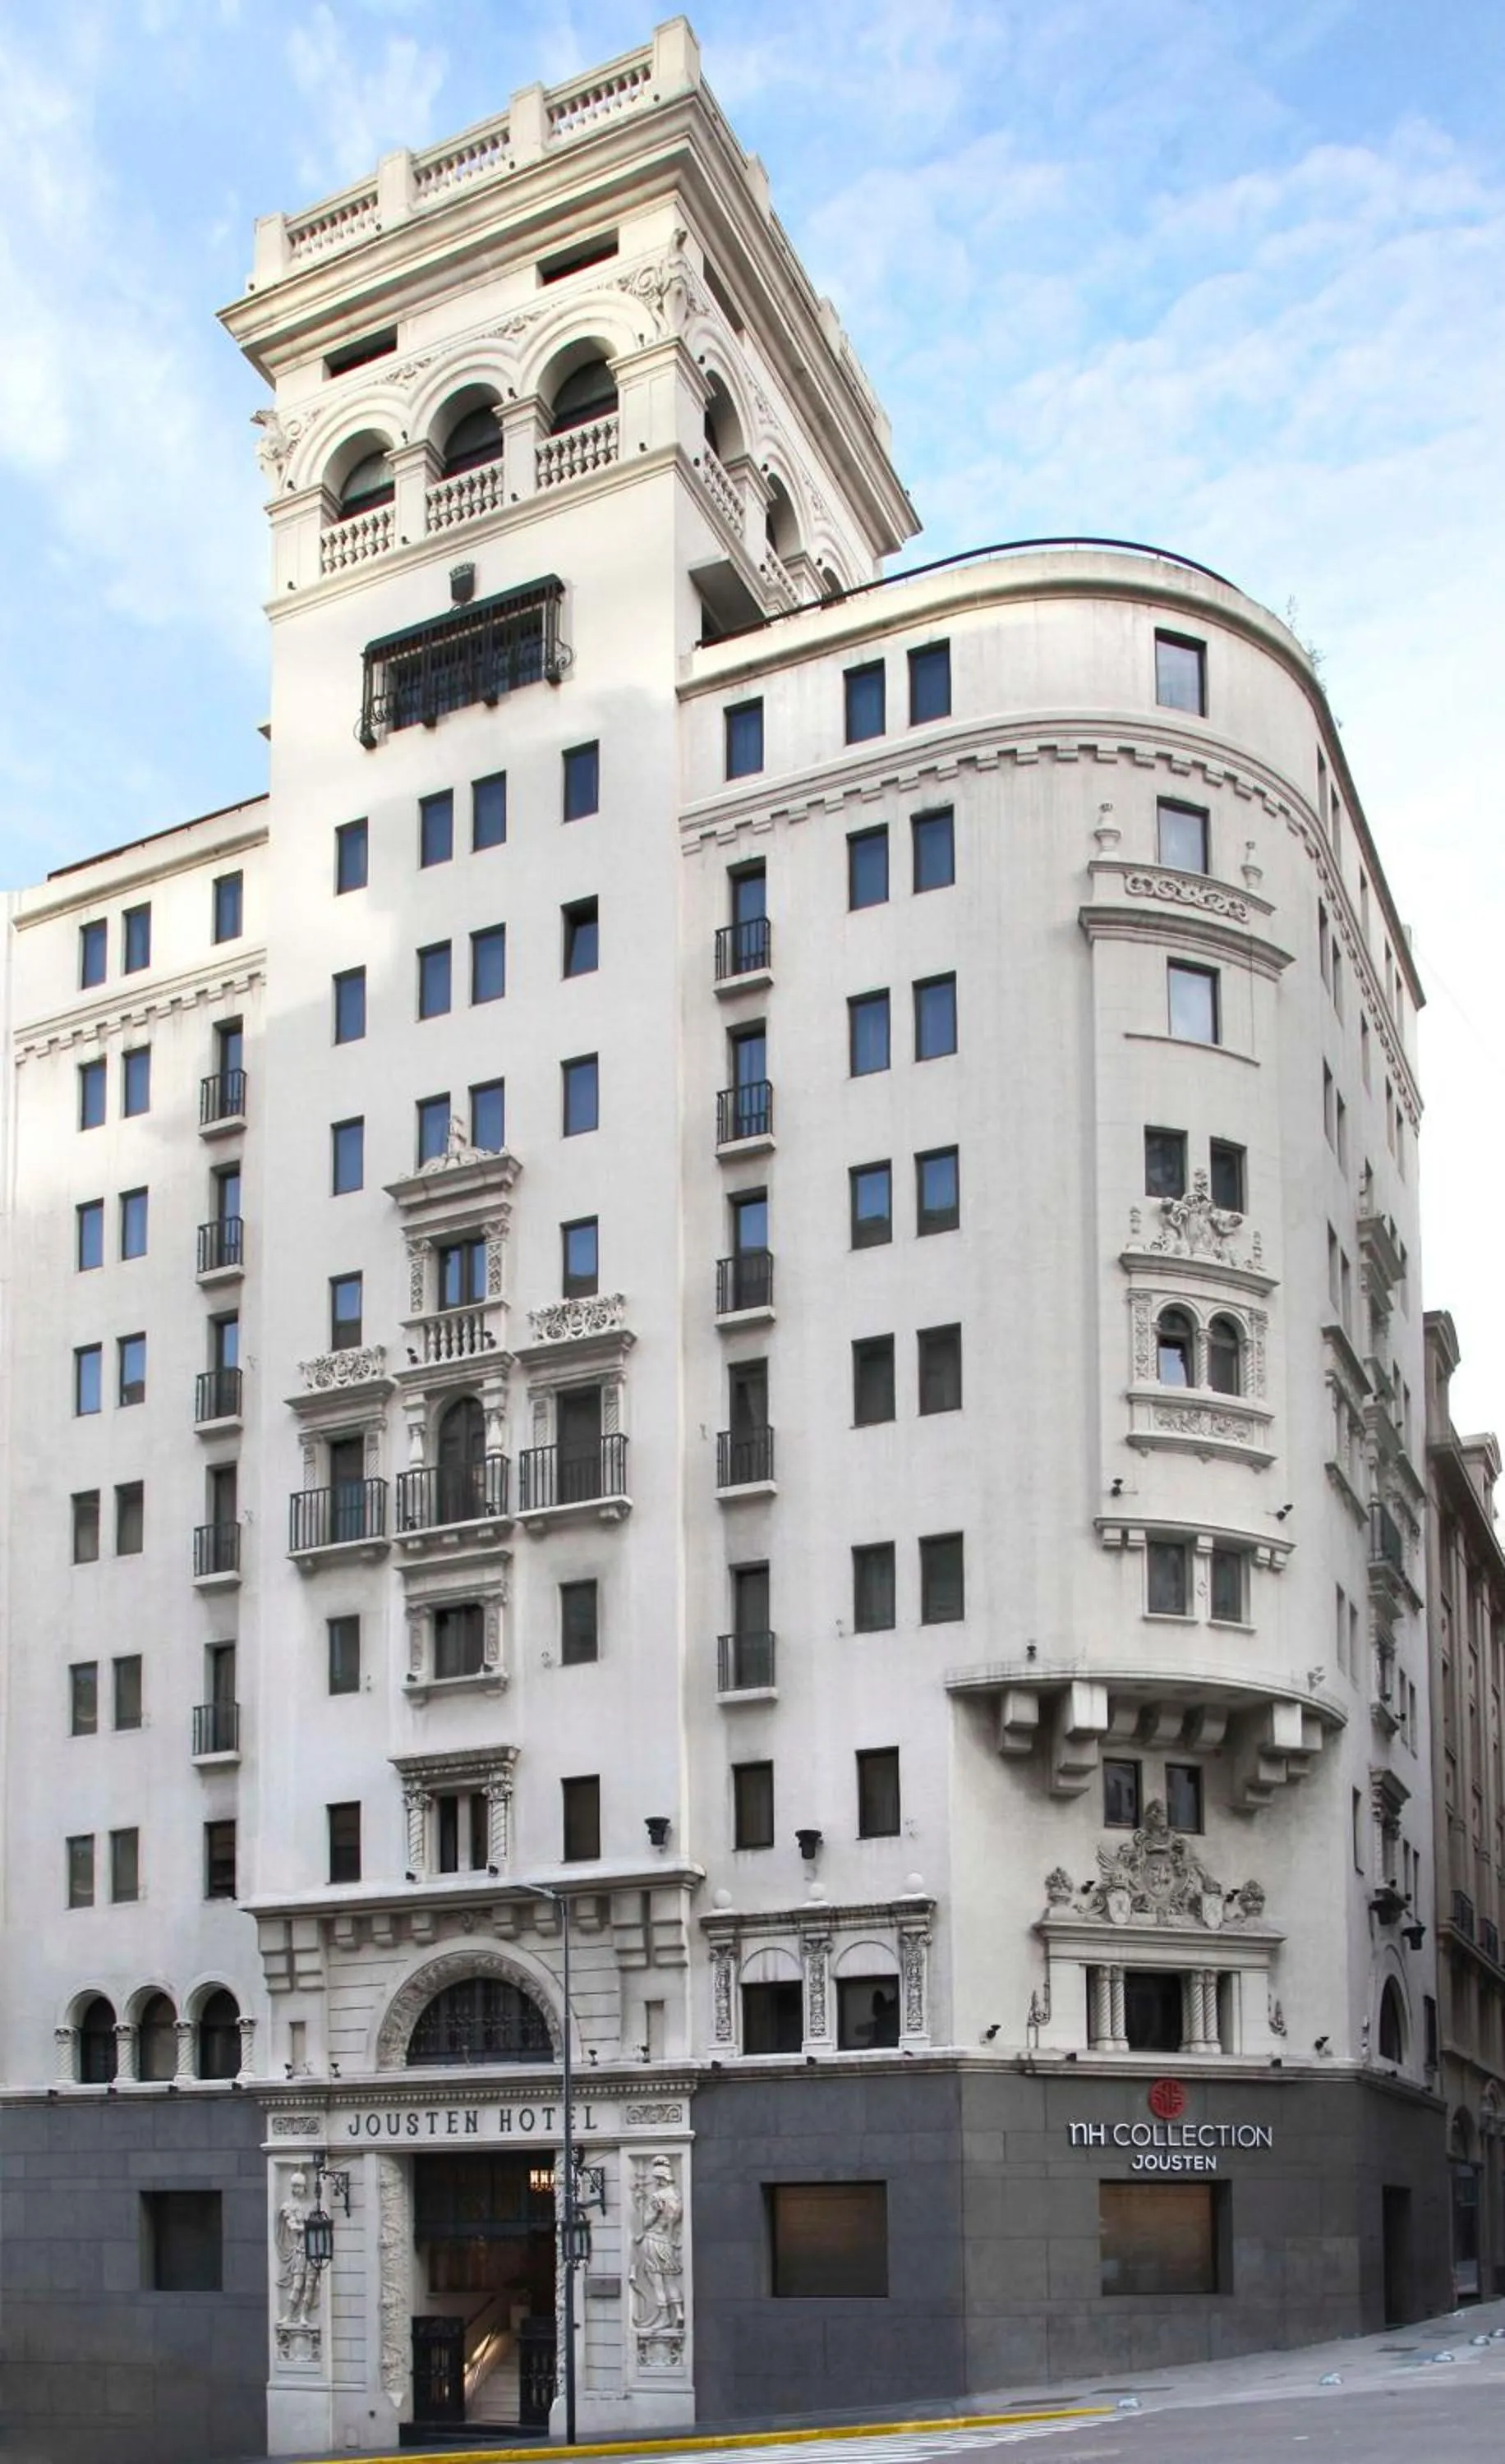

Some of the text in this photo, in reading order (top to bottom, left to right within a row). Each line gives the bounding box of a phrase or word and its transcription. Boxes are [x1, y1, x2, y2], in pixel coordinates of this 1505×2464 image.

[348, 2110, 478, 2136] JOUSTEN
[1113, 2123, 1273, 2147] COLLECTION
[1132, 2154, 1217, 2170] JOUSTEN
